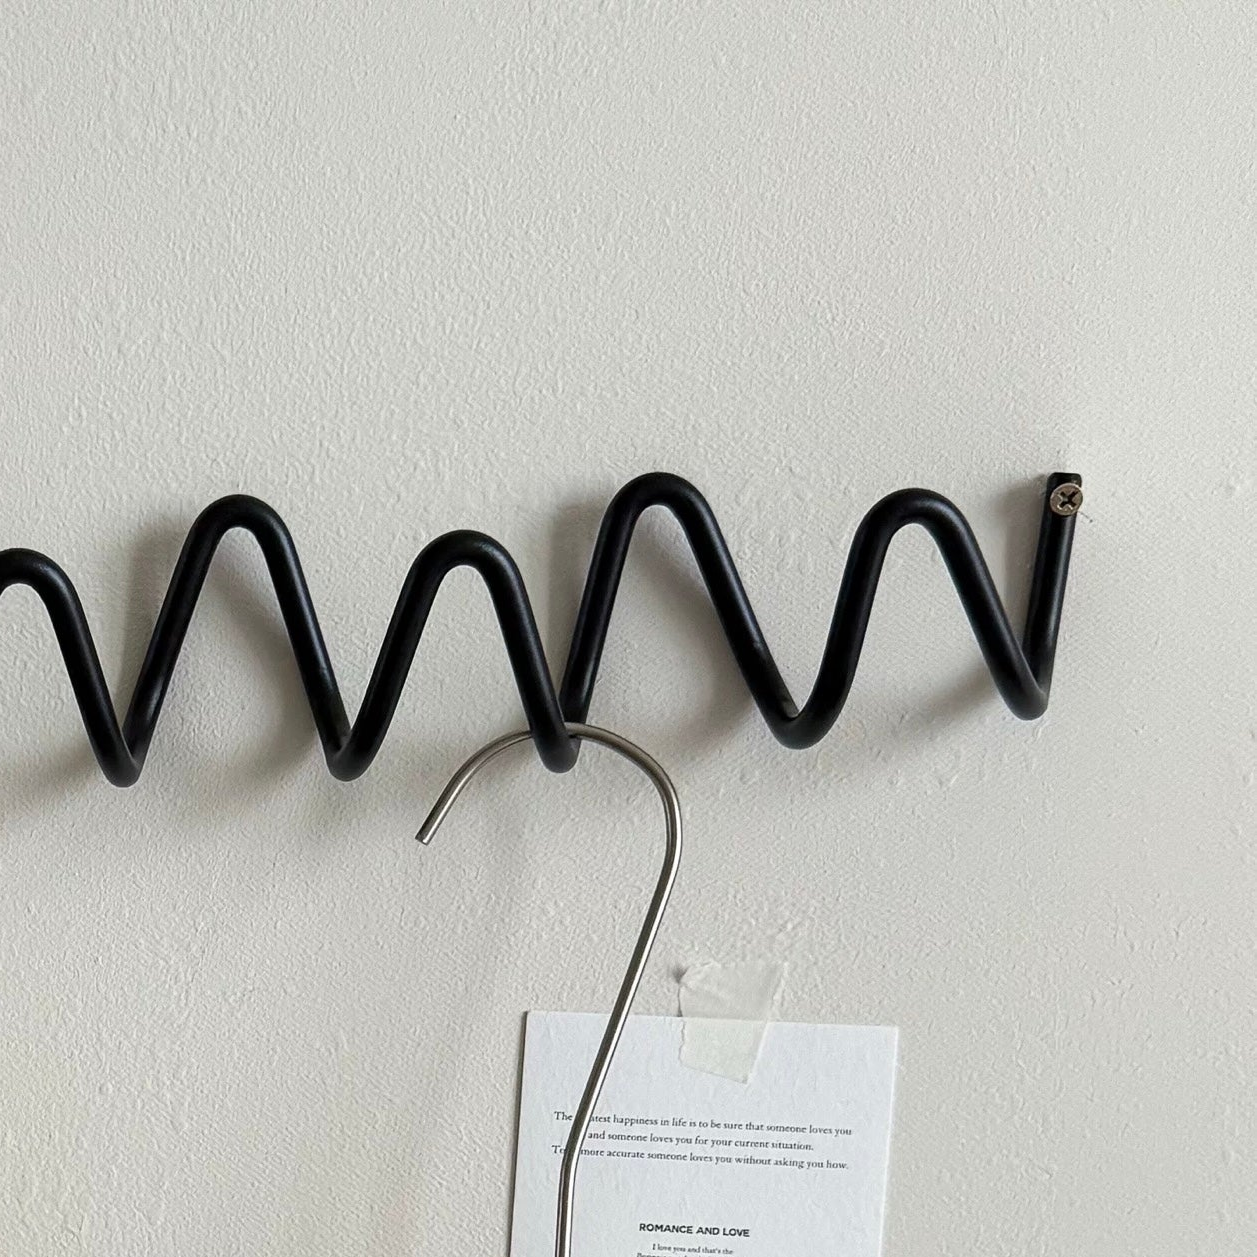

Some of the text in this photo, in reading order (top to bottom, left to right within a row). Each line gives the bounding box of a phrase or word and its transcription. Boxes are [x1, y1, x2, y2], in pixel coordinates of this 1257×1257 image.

[554, 1111, 852, 1137] The atest happiness in life is to be sure that someone loves you
[587, 1130, 814, 1151] and someone loves you for your current situation.
[580, 1149, 605, 1157] more
[606, 1149, 645, 1159] accurate
[647, 1152, 687, 1161] someone
[689, 1152, 713, 1162] loves
[715, 1156, 732, 1166] you
[734, 1155, 772, 1166] without
[773, 1157, 805, 1169] asking
[806, 1160, 824, 1170] you
[826, 1159, 849, 1170] how.
[638, 1222, 751, 1238] ROMANCE AND LOVE
[657, 1243, 672, 1252] love
[673, 1246, 686, 1254] you
[687, 1245, 701, 1254] and
